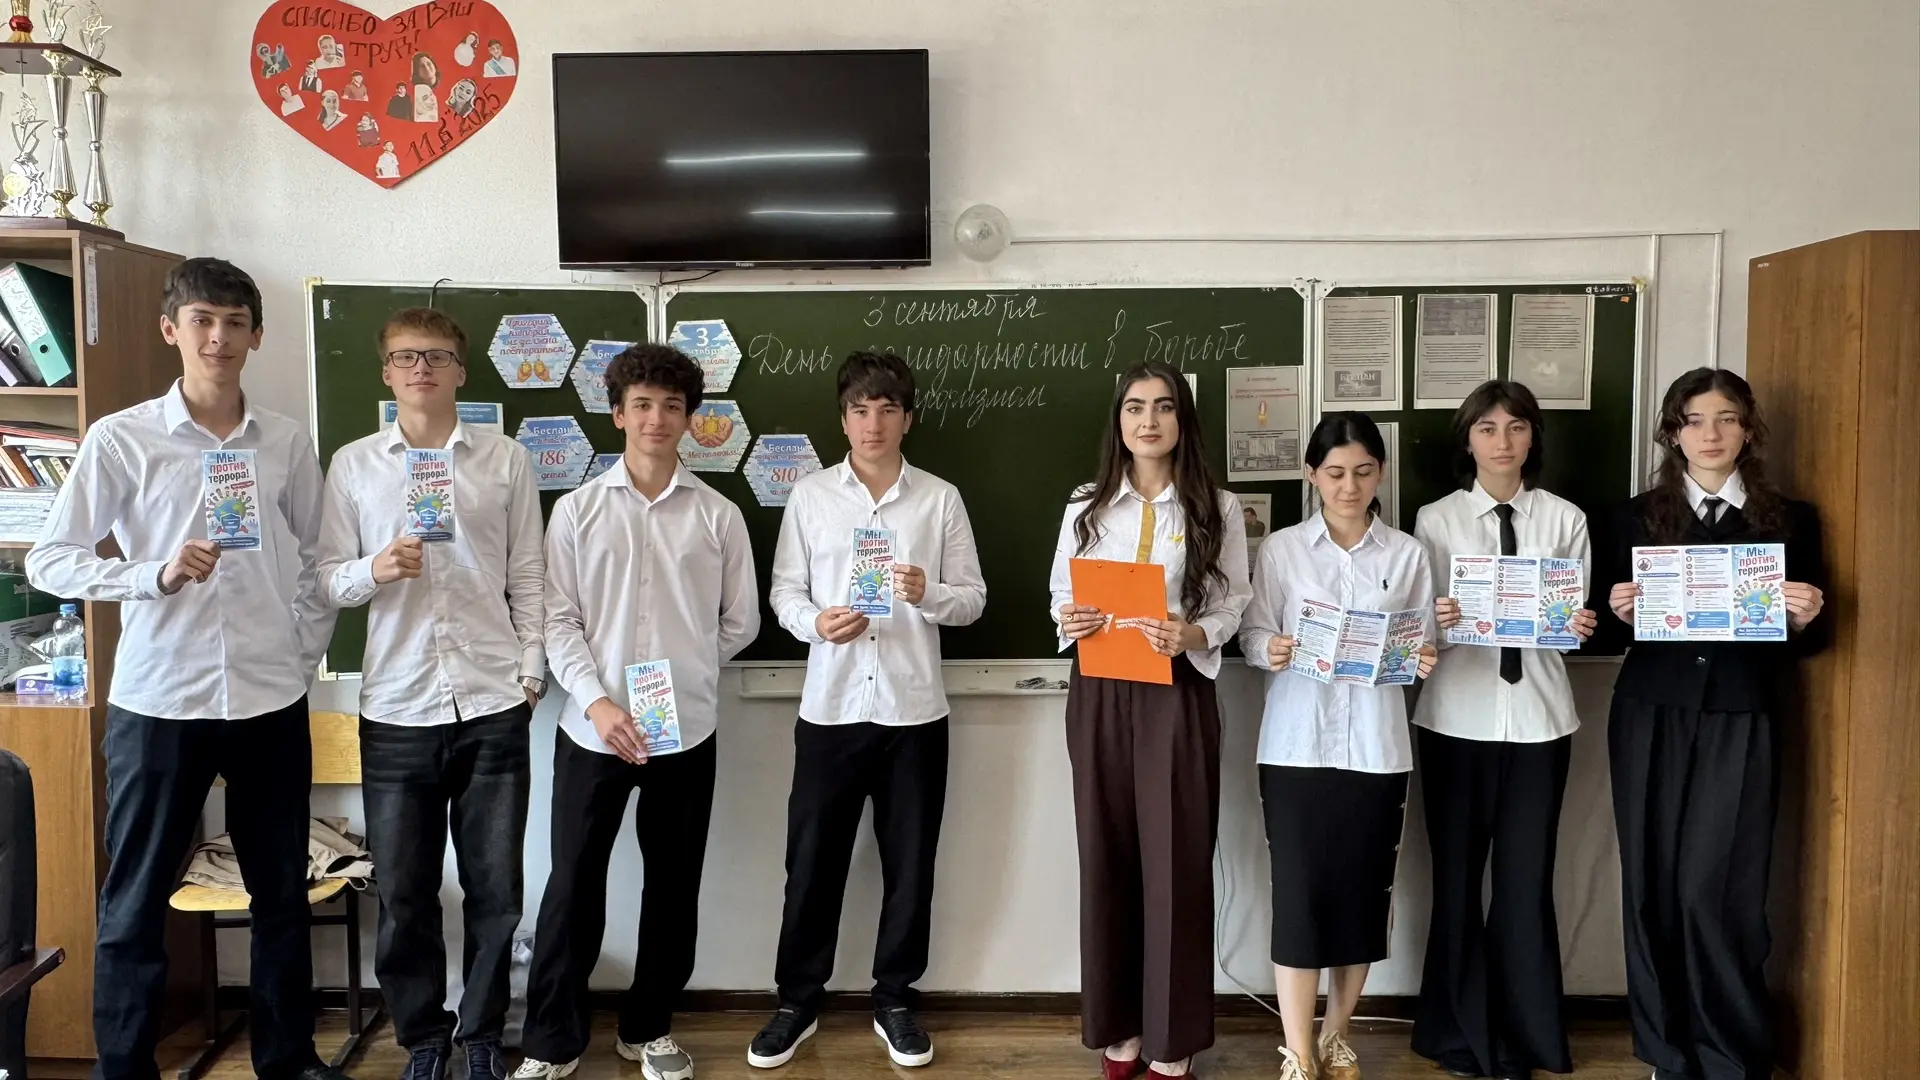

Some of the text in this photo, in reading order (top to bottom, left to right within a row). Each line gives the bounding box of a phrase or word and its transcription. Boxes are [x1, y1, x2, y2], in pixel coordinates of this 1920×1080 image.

[282, 6, 377, 35] СПАСИБО
[393, 13, 417, 34] ЗА
[349, 29, 421, 68] ТРУД!
[864, 294, 1046, 336] 3 сентября
[696, 327, 709, 347] 3
[597, 349, 615, 358] Бес
[749, 333, 833, 375] День
[868, 341, 1092, 392] лидарности
[1104, 309, 1127, 369] в
[769, 444, 804, 452] Беслан
[216, 453, 236, 463] Мы
[419, 452, 437, 462] Мы
[539, 449, 566, 466] 186
[209, 462, 246, 474] против
[412, 462, 445, 472] против
[771, 467, 797, 482] 810
[865, 530, 881, 540] Мы
[859, 539, 888, 548] против
[1746, 546, 1766, 557] Мы
[1551, 560, 1568, 570] Мы
[1739, 556, 1776, 567] против
[1545, 569, 1575, 579] против
[638, 665, 655, 676] Мы
[634, 671, 664, 686] против
